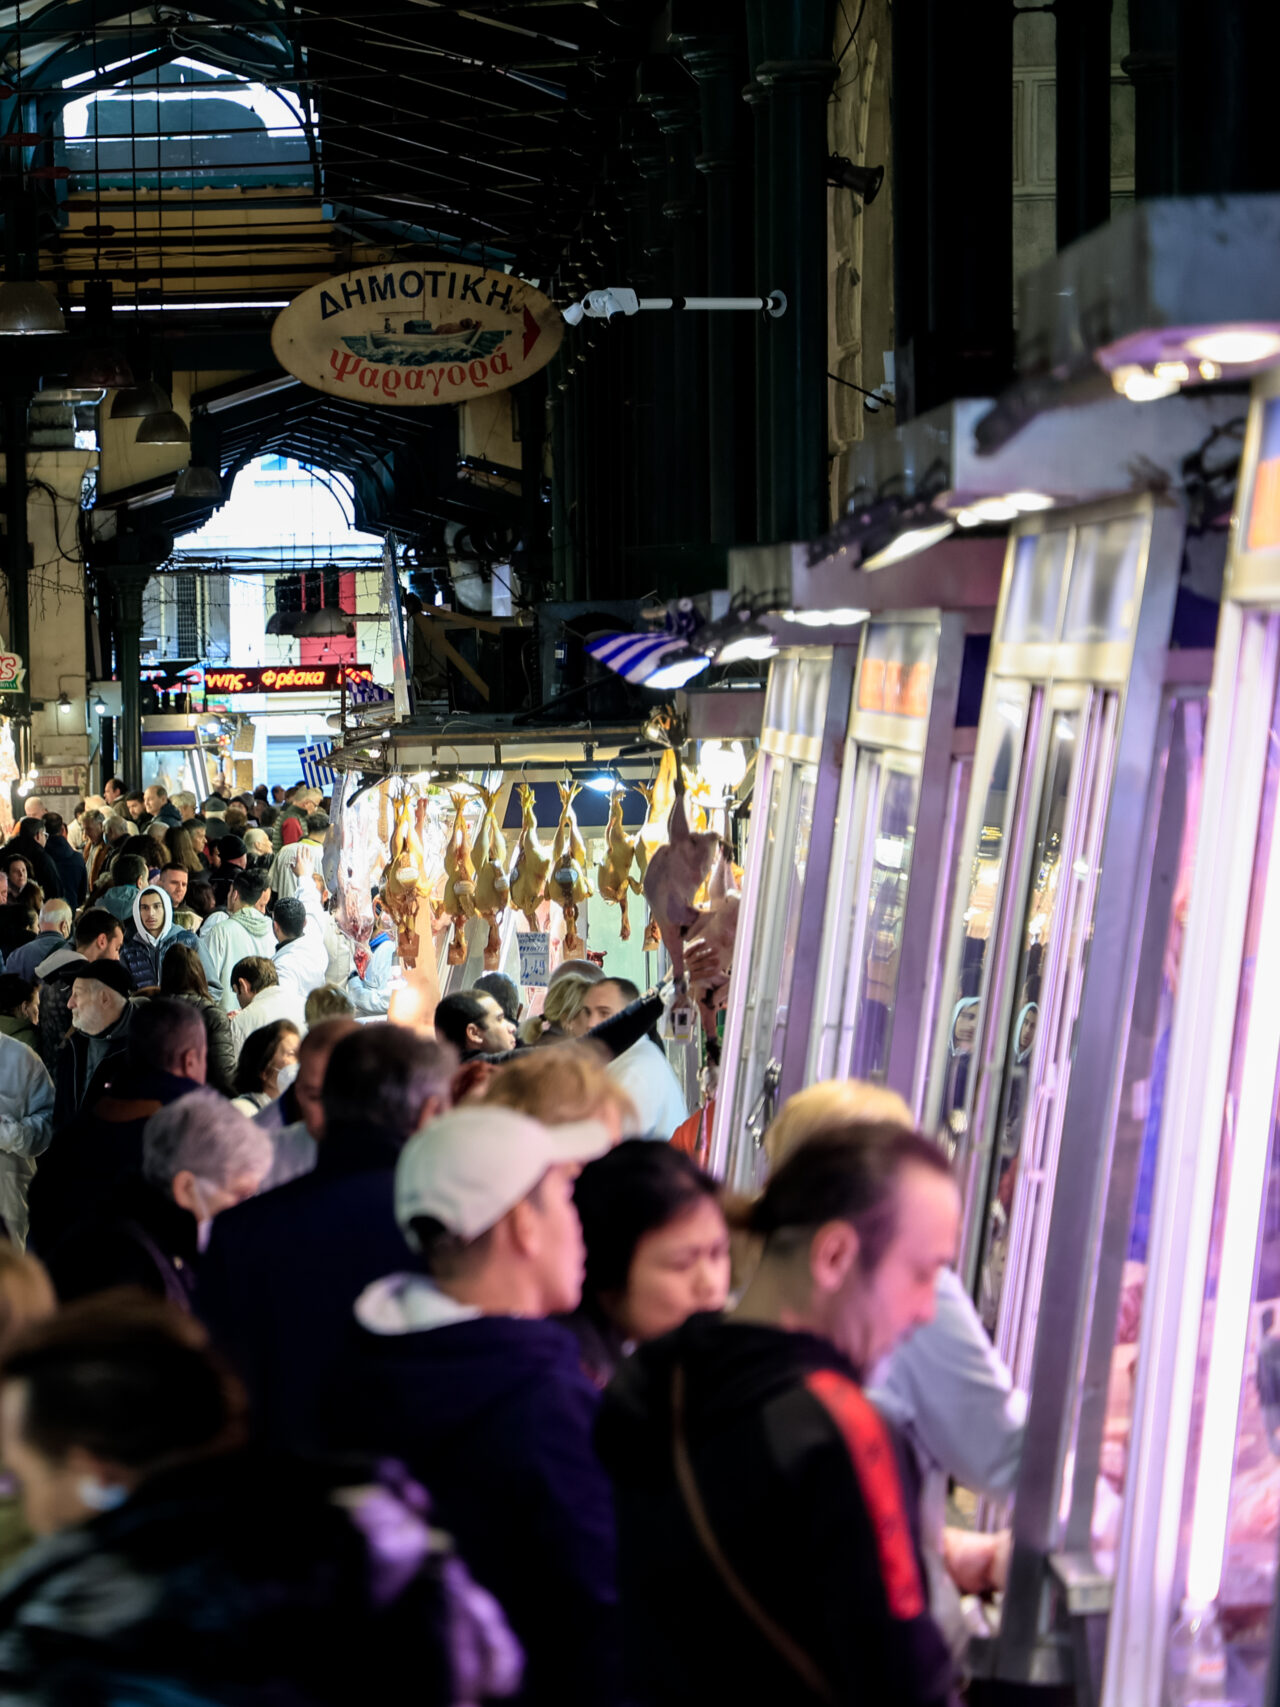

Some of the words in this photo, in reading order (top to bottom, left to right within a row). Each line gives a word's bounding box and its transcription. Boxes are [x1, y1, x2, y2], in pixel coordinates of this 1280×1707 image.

[319, 269, 515, 321] ΔΗΜΟΤΙΚΗ
[328, 346, 513, 398] Ψαραγορά
[260, 669, 325, 690] Φρέσκα
